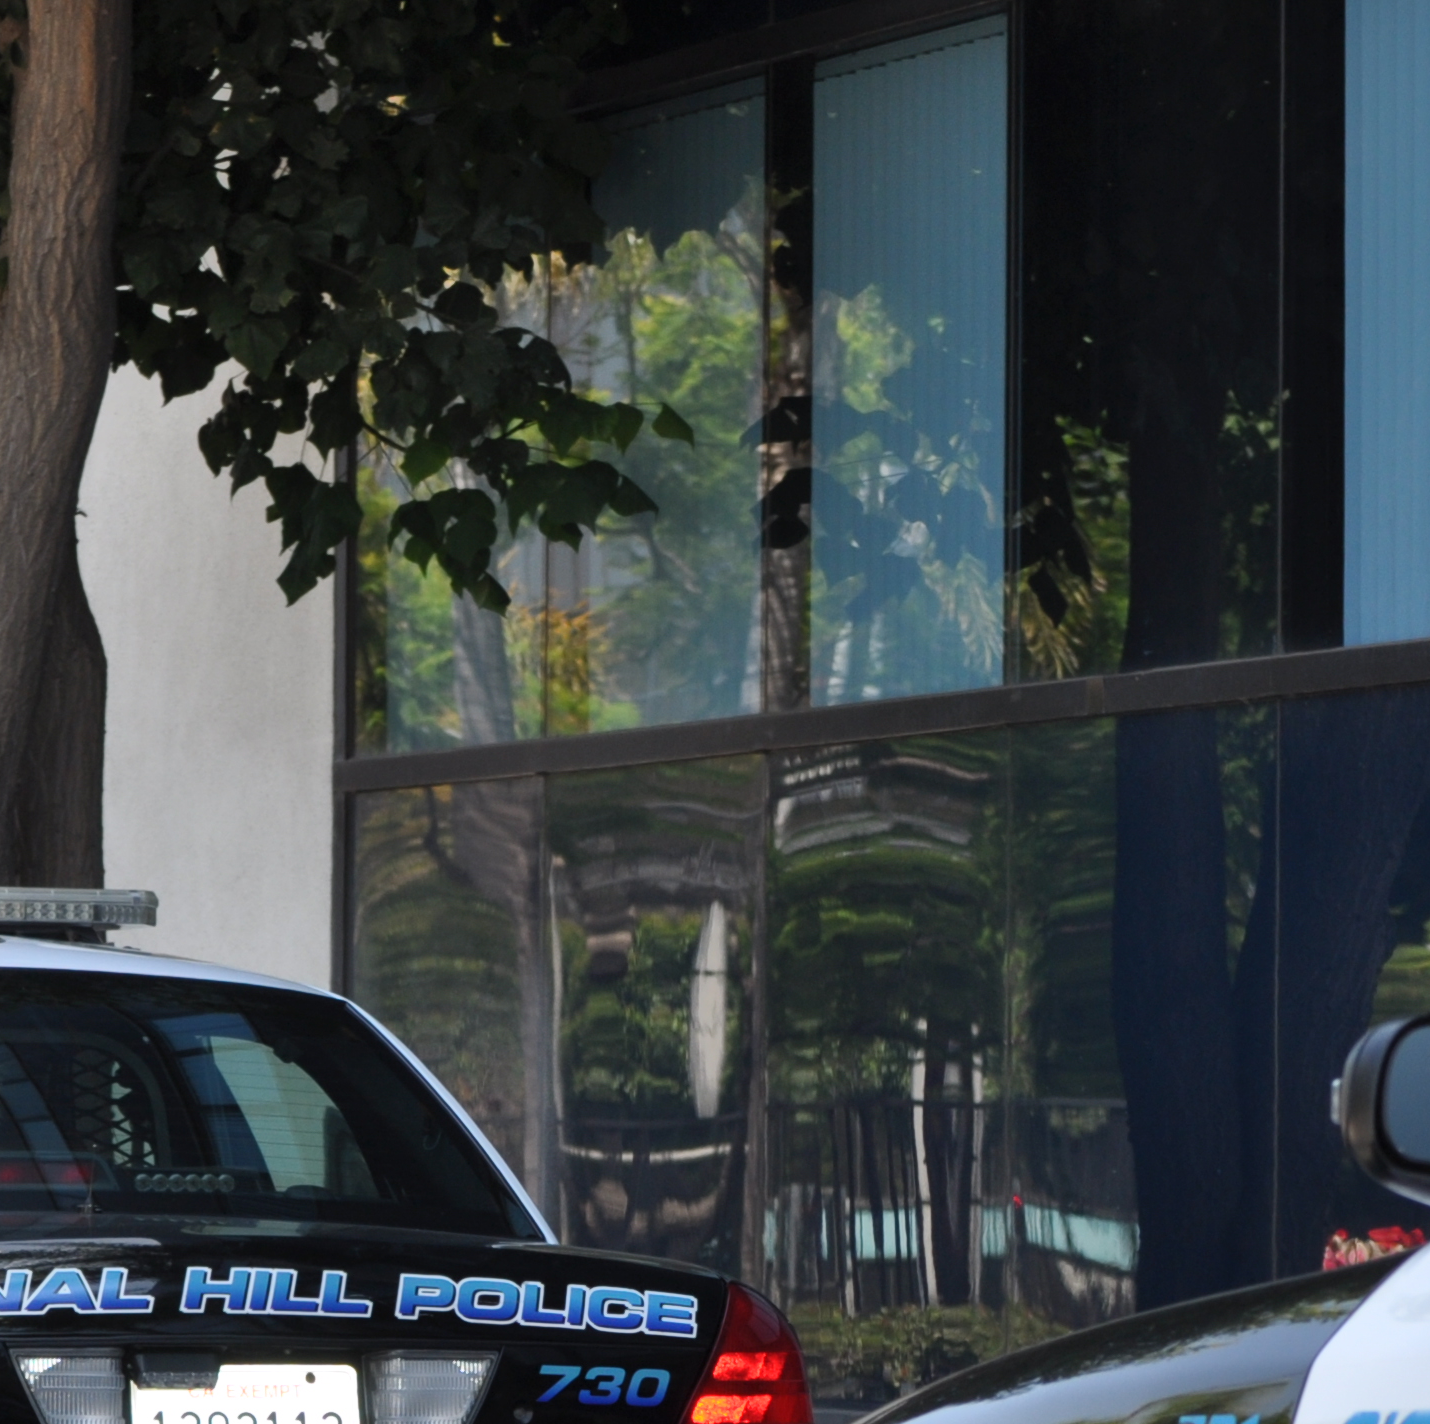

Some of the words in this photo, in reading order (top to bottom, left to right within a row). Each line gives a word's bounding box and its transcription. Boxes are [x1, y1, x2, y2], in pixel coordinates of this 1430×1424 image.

[179, 1266, 372, 1318] HILL
[394, 1273, 698, 1338] POLICE
[226, 1384, 302, 1398] EXEMPT
[536, 1364, 671, 1407] 730
